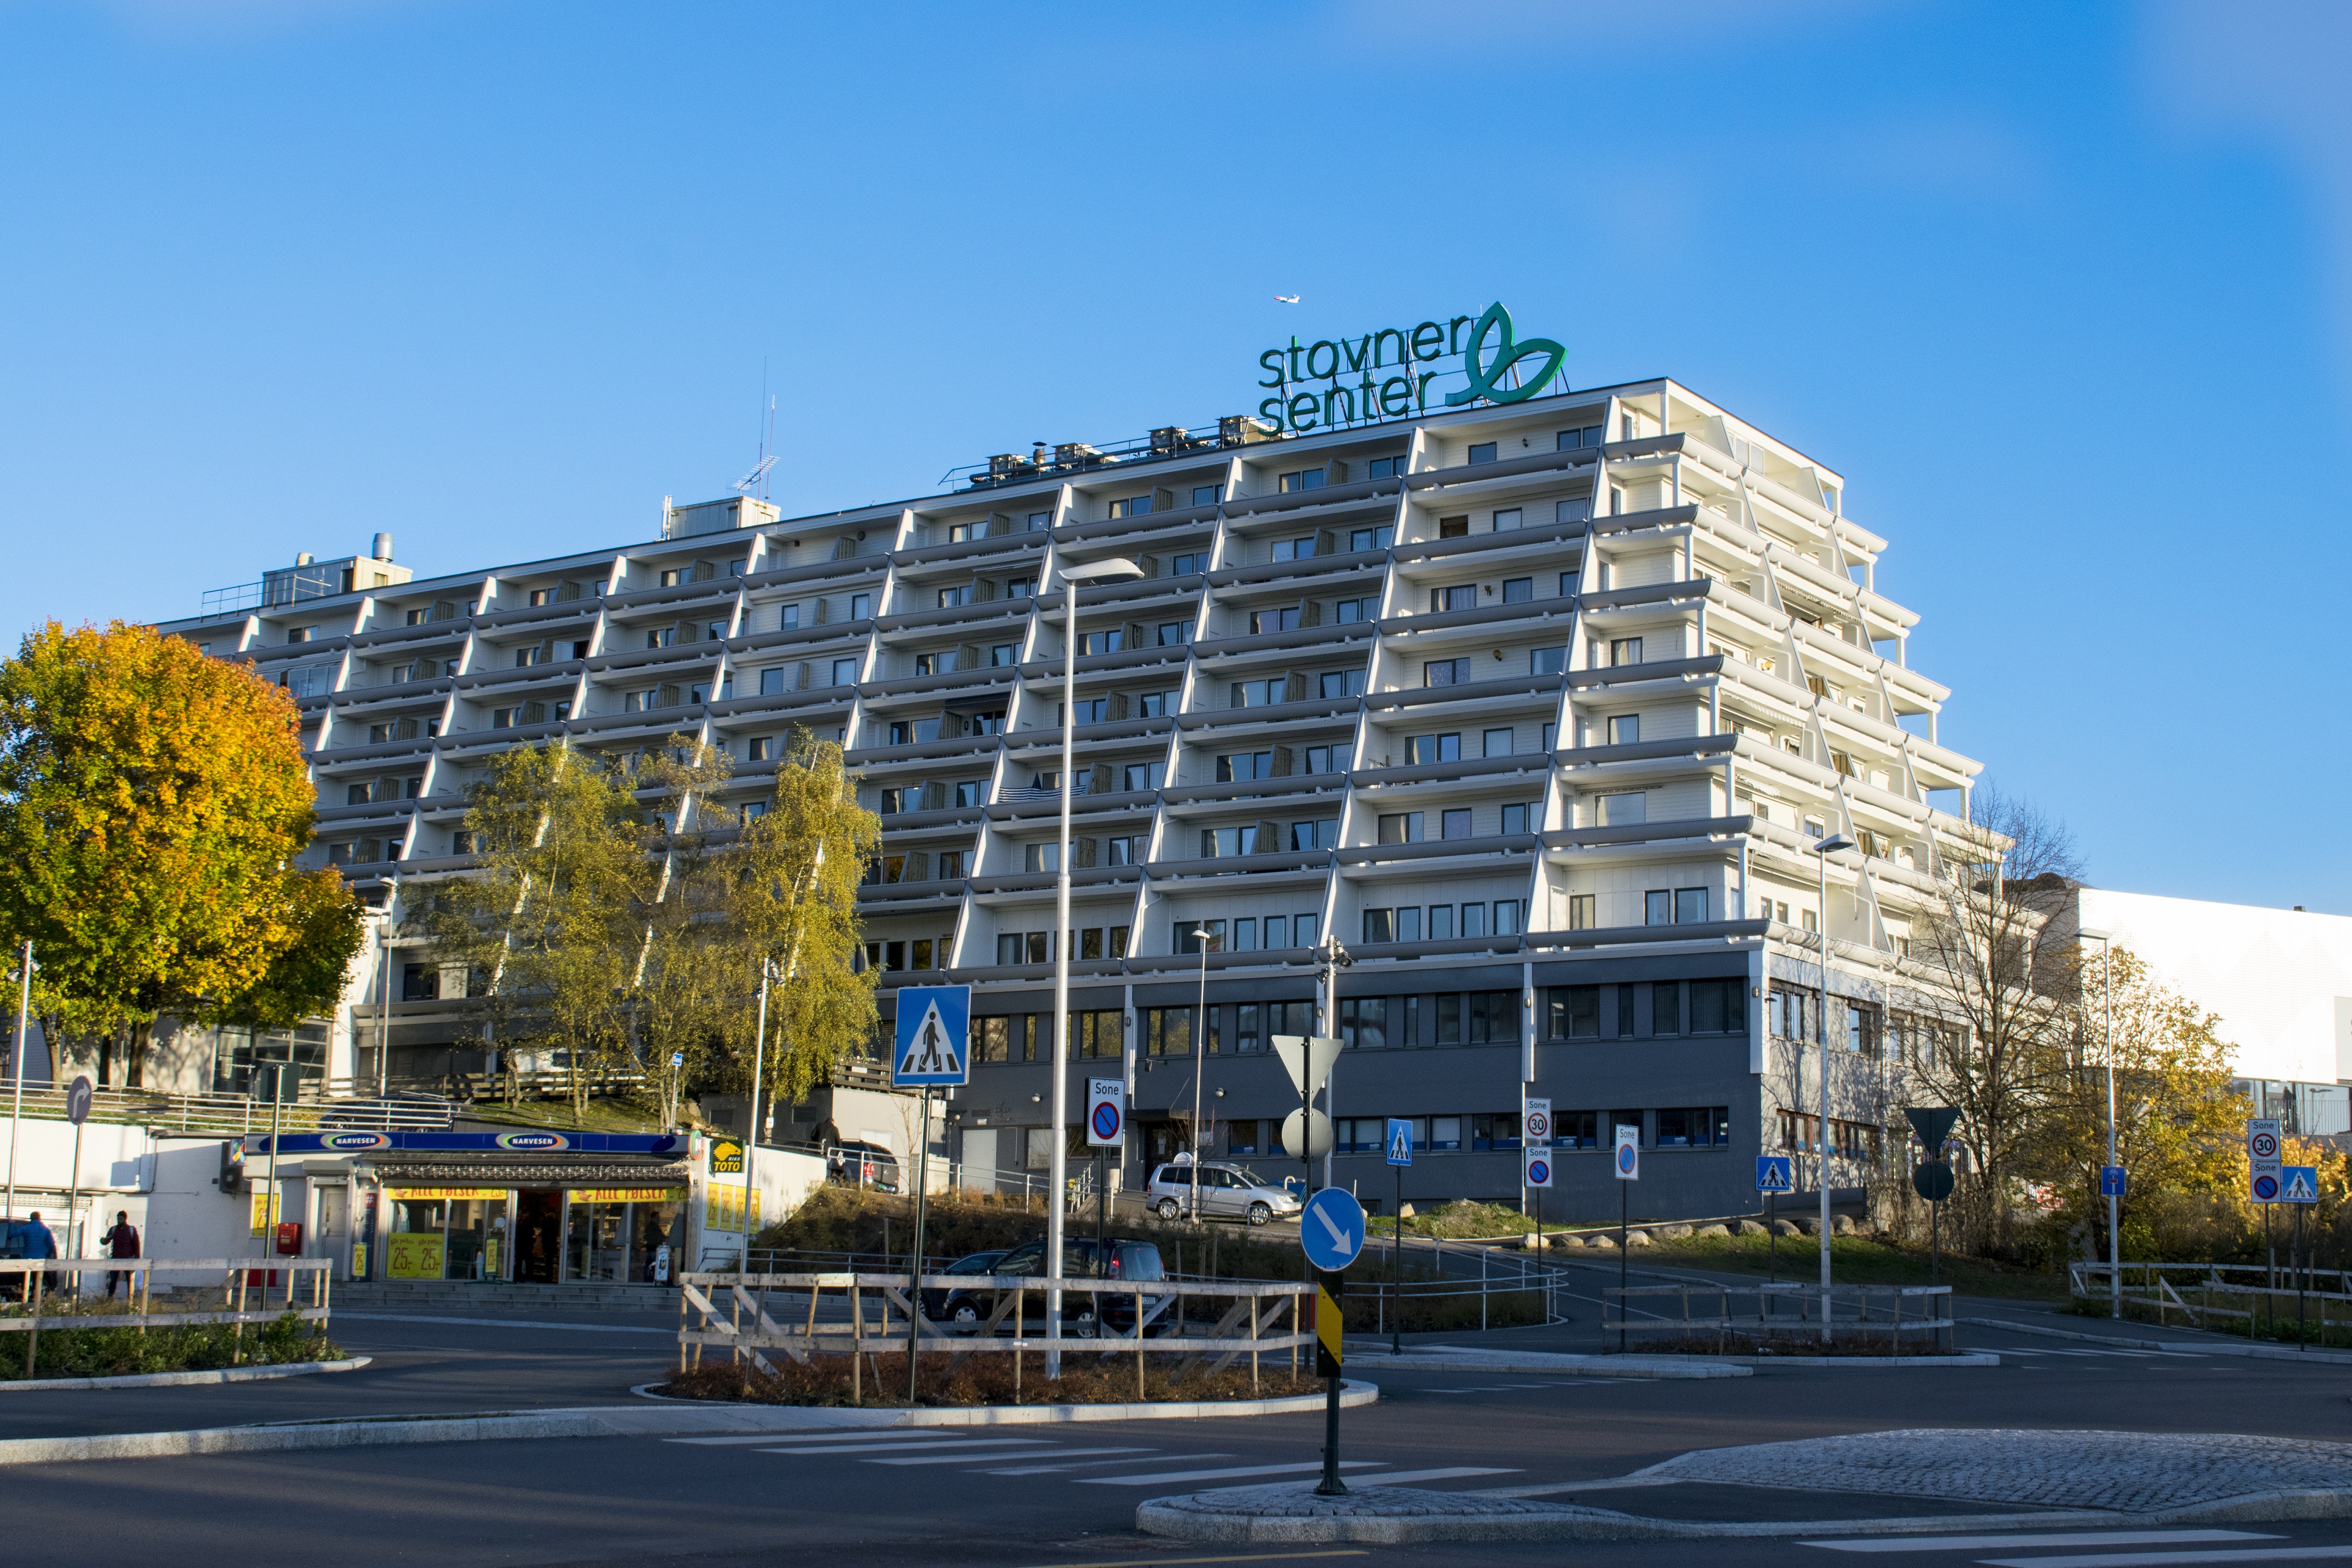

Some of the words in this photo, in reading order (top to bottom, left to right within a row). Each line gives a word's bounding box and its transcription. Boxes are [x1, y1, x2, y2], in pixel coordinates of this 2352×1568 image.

[1259, 315, 1470, 388] stovner
[1258, 371, 1437, 437] senter
[1095, 1082, 1119, 1096] Sone
[1529, 1101, 1547, 1110] Sone
[1531, 1119, 1544, 1131] 30
[2253, 1121, 2274, 1129] Sone
[1620, 1128, 1635, 1139] Sone
[2256, 1139, 2273, 1151] 30
[1530, 1148, 1548, 1157] Sone
[714, 1161, 741, 1172] TOTO
[2255, 1163, 2276, 1172] Sone
